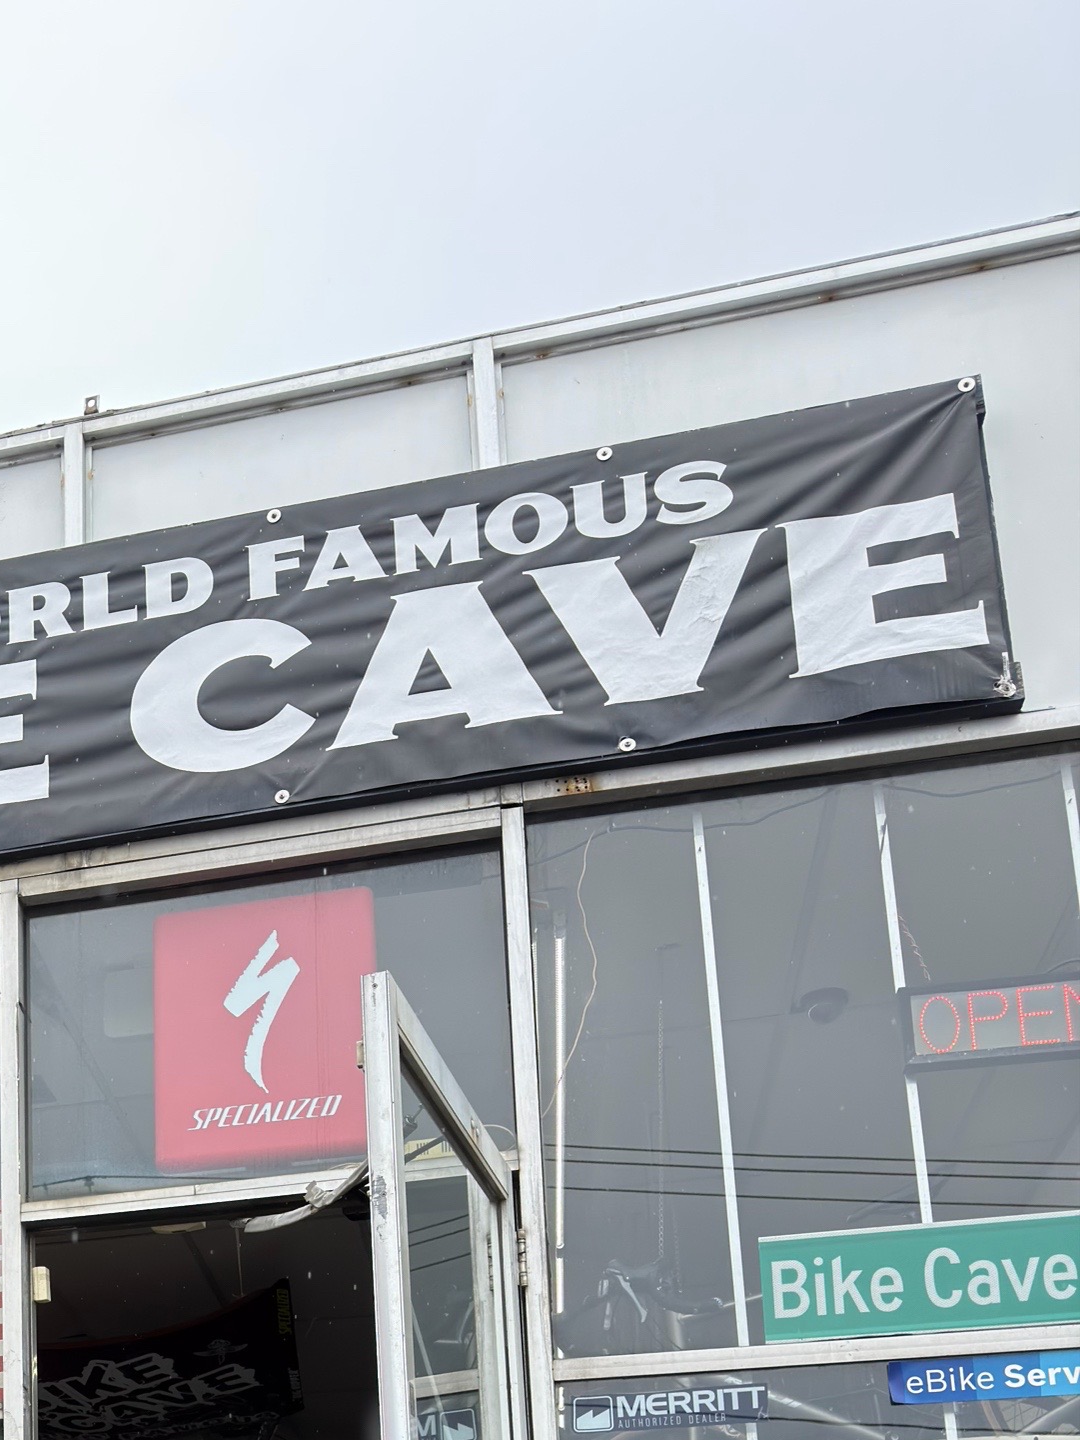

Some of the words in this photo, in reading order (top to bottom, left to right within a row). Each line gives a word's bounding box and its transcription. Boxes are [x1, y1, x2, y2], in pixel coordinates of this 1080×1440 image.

[247, 460, 734, 601] FAMOUS
[129, 492, 989, 773] CAVE
[187, 1094, 343, 1131] SPECIALIZED
[770, 1256, 904, 1319] Bike
[924, 1247, 1078, 1308] Cave
[38, 1352, 182, 1412] IKE
[616, 1386, 766, 1418] MERRITT
[906, 1366, 995, 1394] eBike
[618, 1415, 682, 1429] AUTHORIZED
[688, 1413, 727, 1424] DEALER
